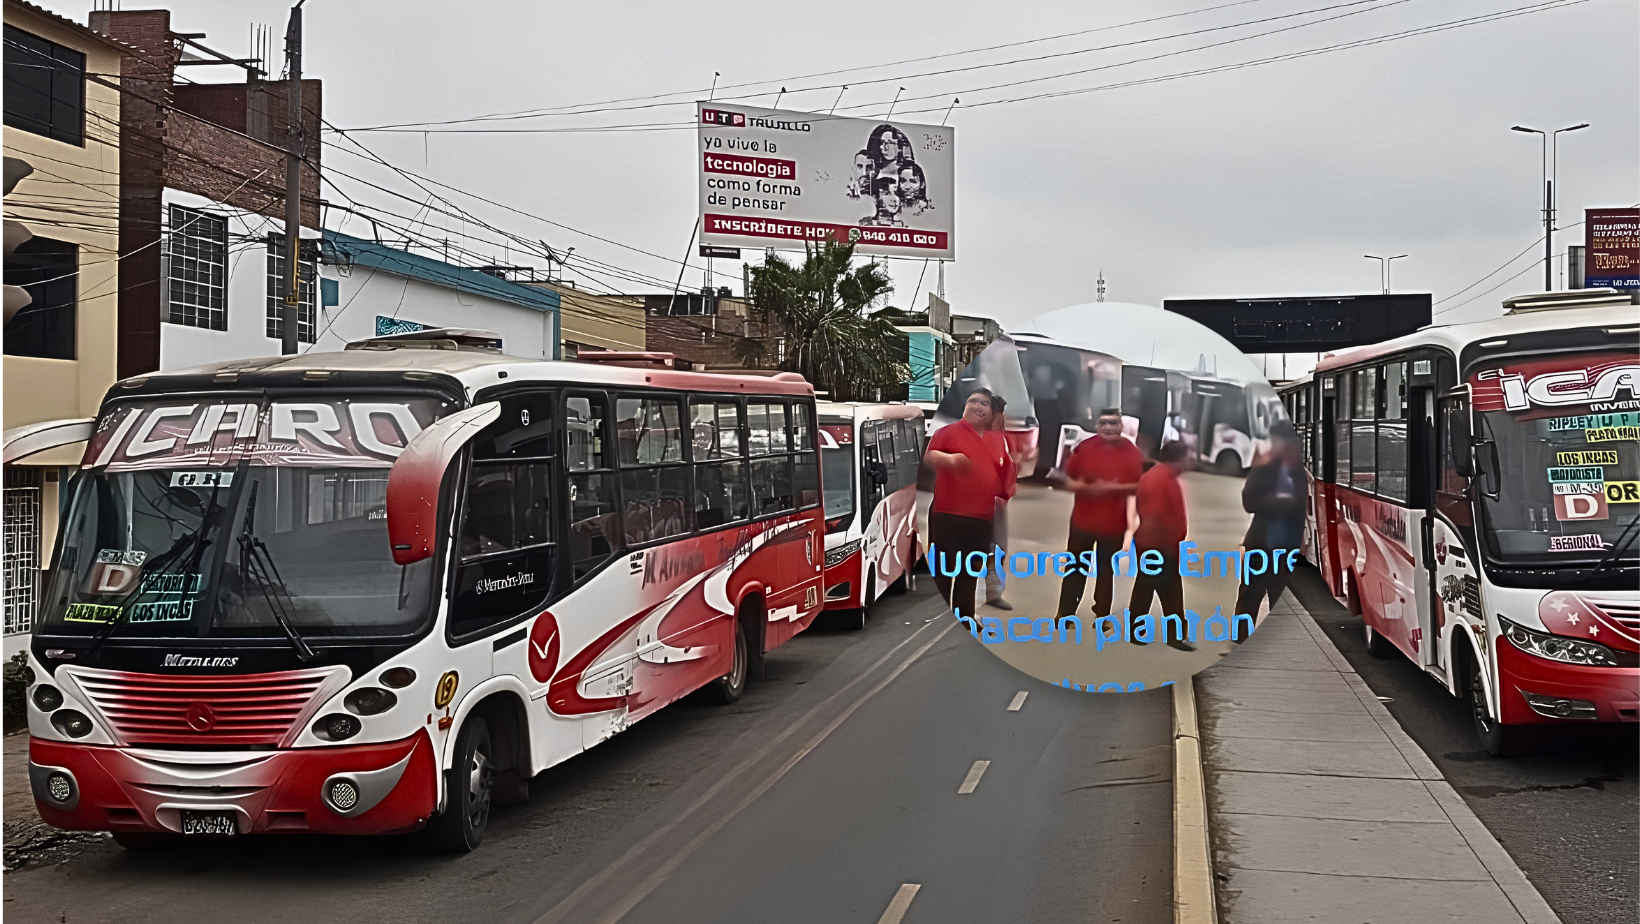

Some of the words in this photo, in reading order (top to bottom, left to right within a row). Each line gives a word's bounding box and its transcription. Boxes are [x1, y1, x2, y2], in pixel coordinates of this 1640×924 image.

[704, 110, 745, 126] UTP
[748, 117, 811, 132] TRUJILLO
[727, 137, 759, 152] vivo
[705, 156, 791, 178] tecnología
[707, 178, 751, 191] como
[756, 179, 801, 196] forma
[707, 191, 727, 205] de
[732, 196, 786, 210] pensar
[1549, 416, 1594, 430] RIPLEY
[93, 403, 424, 466] ICARO
[1559, 452, 1580, 466] LOS
[1582, 451, 1616, 464] INCAS
[1565, 494, 1599, 519] D
[97, 564, 133, 592] D
[132, 604, 155, 621] LOS
